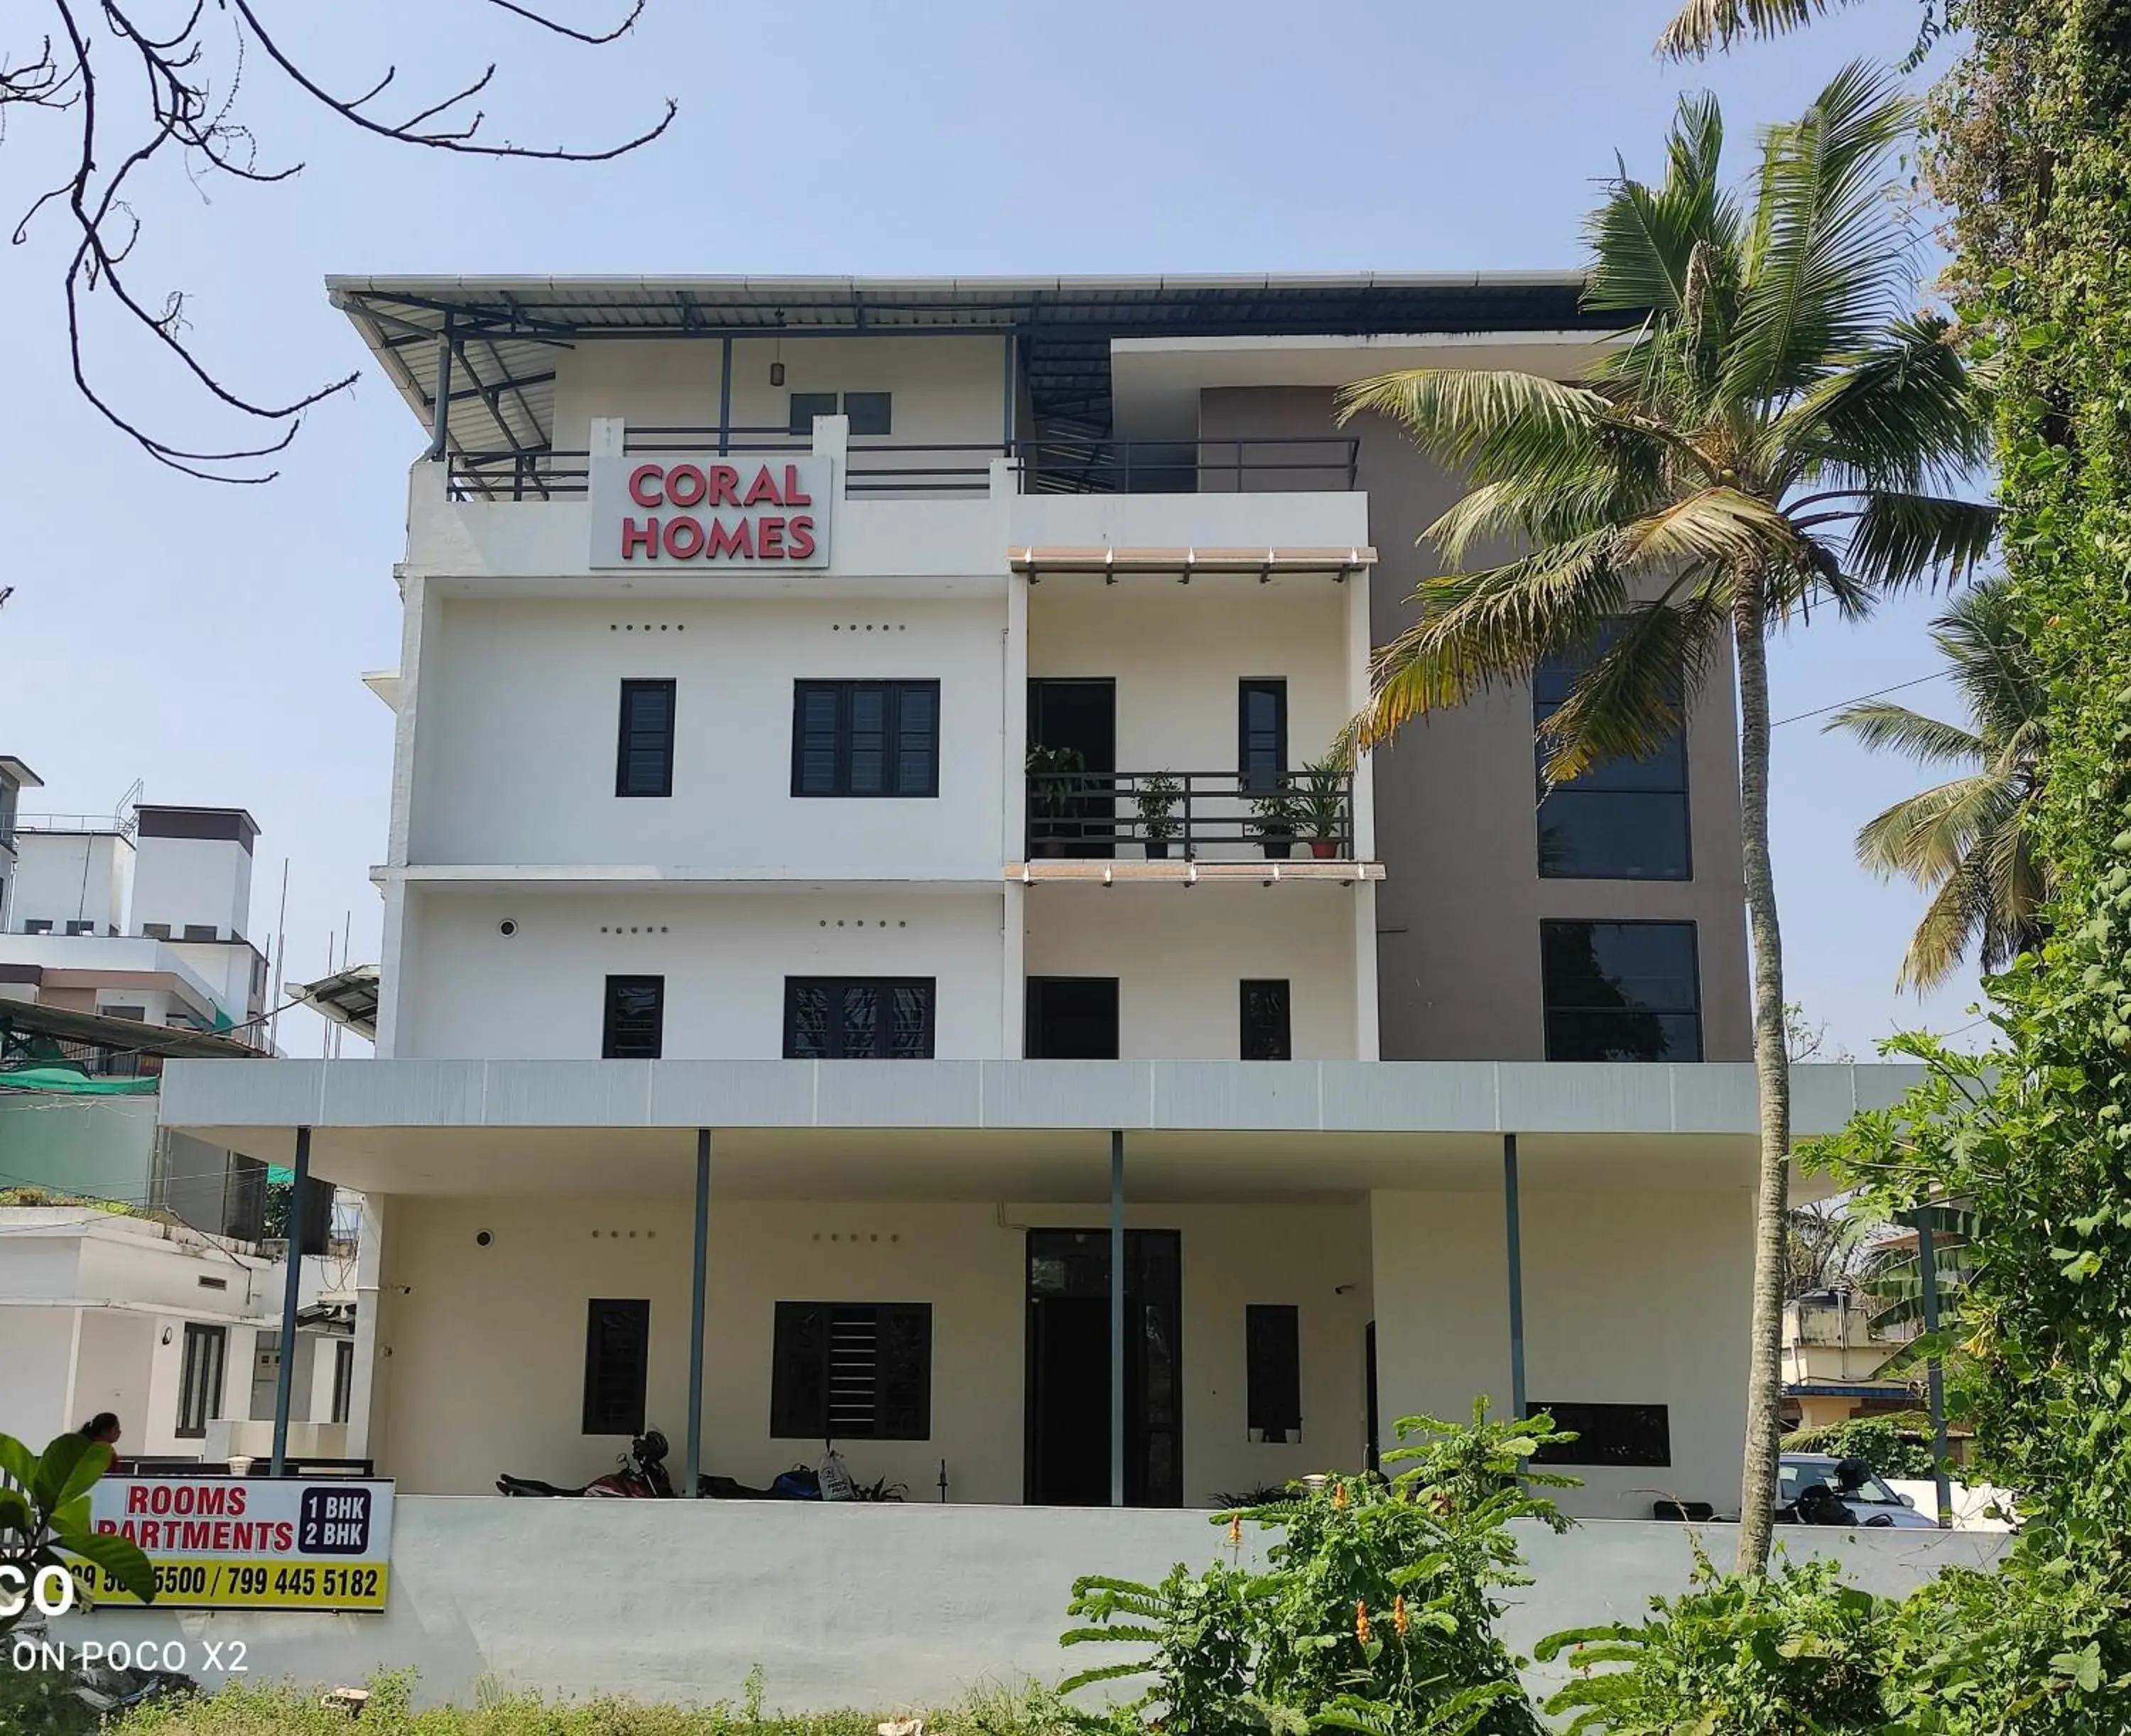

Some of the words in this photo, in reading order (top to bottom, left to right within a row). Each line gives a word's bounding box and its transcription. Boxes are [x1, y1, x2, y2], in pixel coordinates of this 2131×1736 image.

[629, 464, 812, 508] CORAL
[622, 516, 815, 560] HOMES
[127, 1485, 246, 1516] ROOMS
[308, 1496, 318, 1519] 1
[325, 1496, 365, 1520] BHK
[97, 1519, 293, 1551] PARTMENTS
[305, 1522, 318, 1546] 2
[323, 1522, 363, 1546] BHK
[228, 1567, 269, 1595] 799
[274, 1568, 316, 1597] 445
[322, 1568, 379, 1597] 5182
